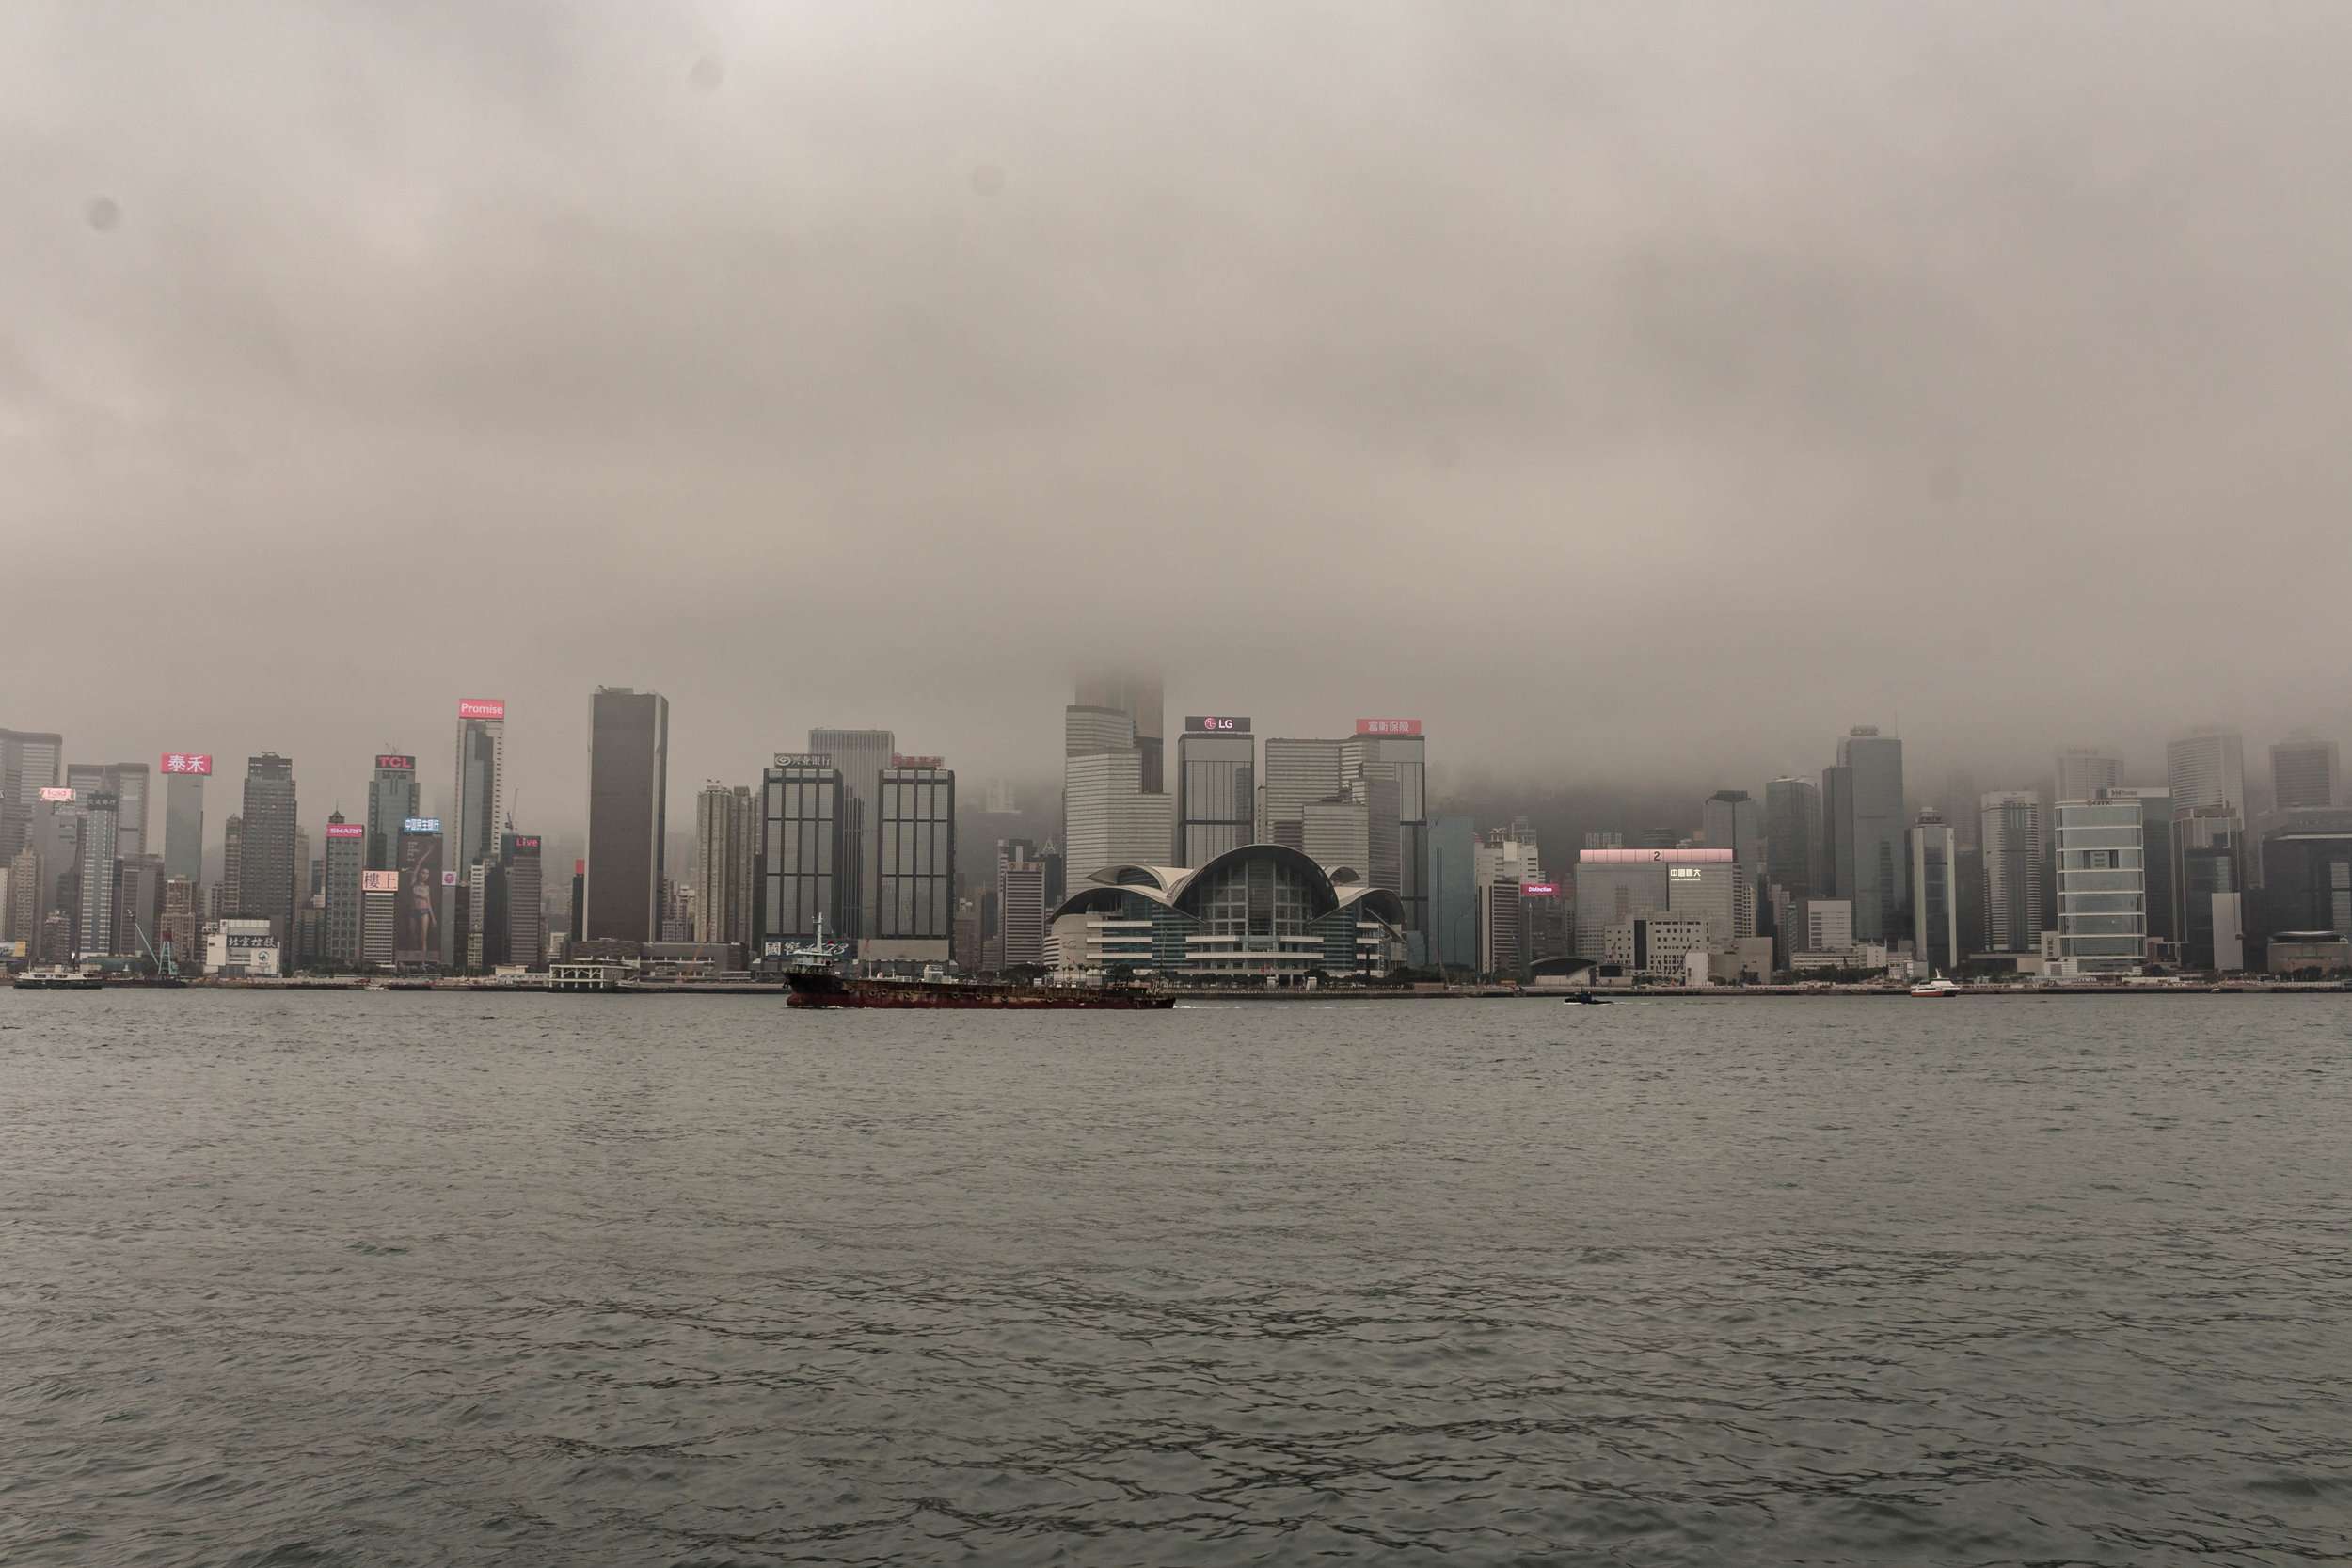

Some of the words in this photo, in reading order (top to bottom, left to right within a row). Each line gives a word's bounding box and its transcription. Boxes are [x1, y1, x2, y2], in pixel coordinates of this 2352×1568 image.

[462, 703, 503, 714] Promise
[1219, 719, 1232, 729] LG
[167, 754, 205, 772] 泰禾
[379, 756, 412, 768] TCL
[1654, 850, 1661, 861] 2
[364, 871, 397, 890] 樓上
